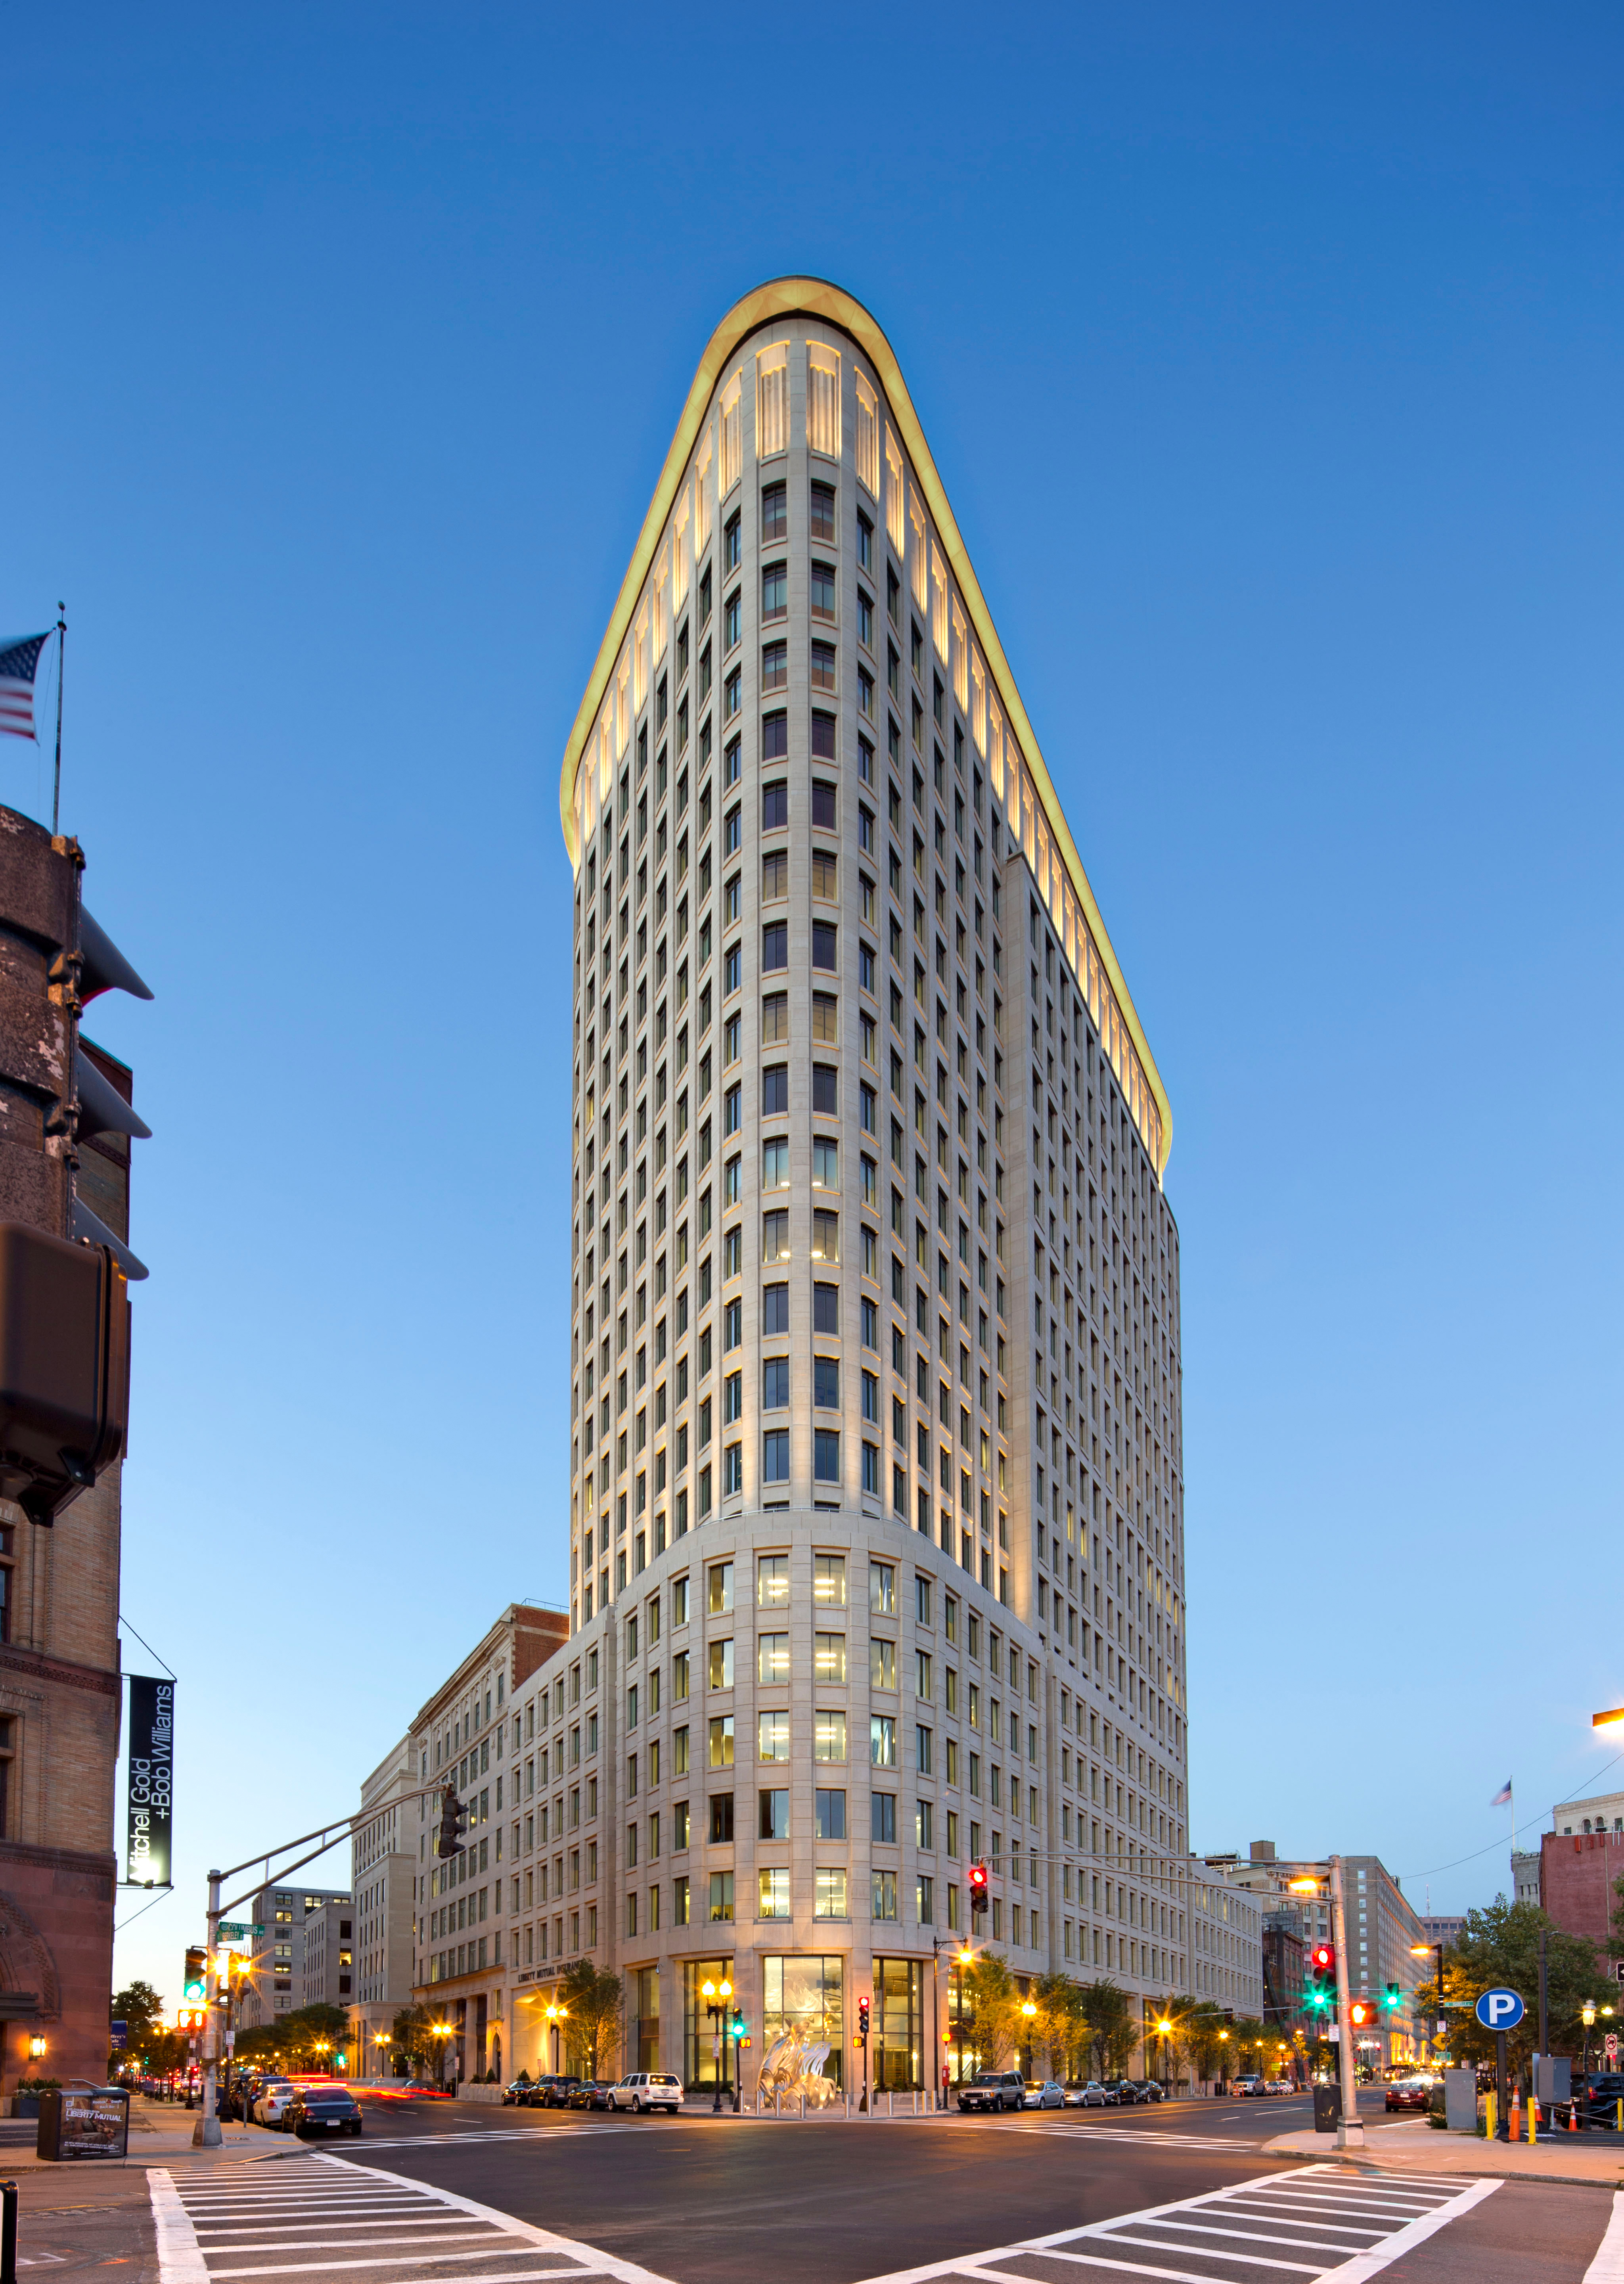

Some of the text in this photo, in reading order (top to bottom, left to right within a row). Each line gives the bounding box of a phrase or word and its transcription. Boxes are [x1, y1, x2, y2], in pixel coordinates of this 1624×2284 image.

[151, 1685, 171, 1763] Williams
[129, 1757, 151, 1880] Mitchell Gold
[222, 1931, 239, 1940] BERKELEY
[228, 1924, 258, 1934] COLUMBUS
[518, 1960, 582, 1983] LIBERTY MUTUAL INSURAN
[1489, 1994, 1515, 2024] P
[66, 2110, 123, 2121] LIBERTY MUTUAL
